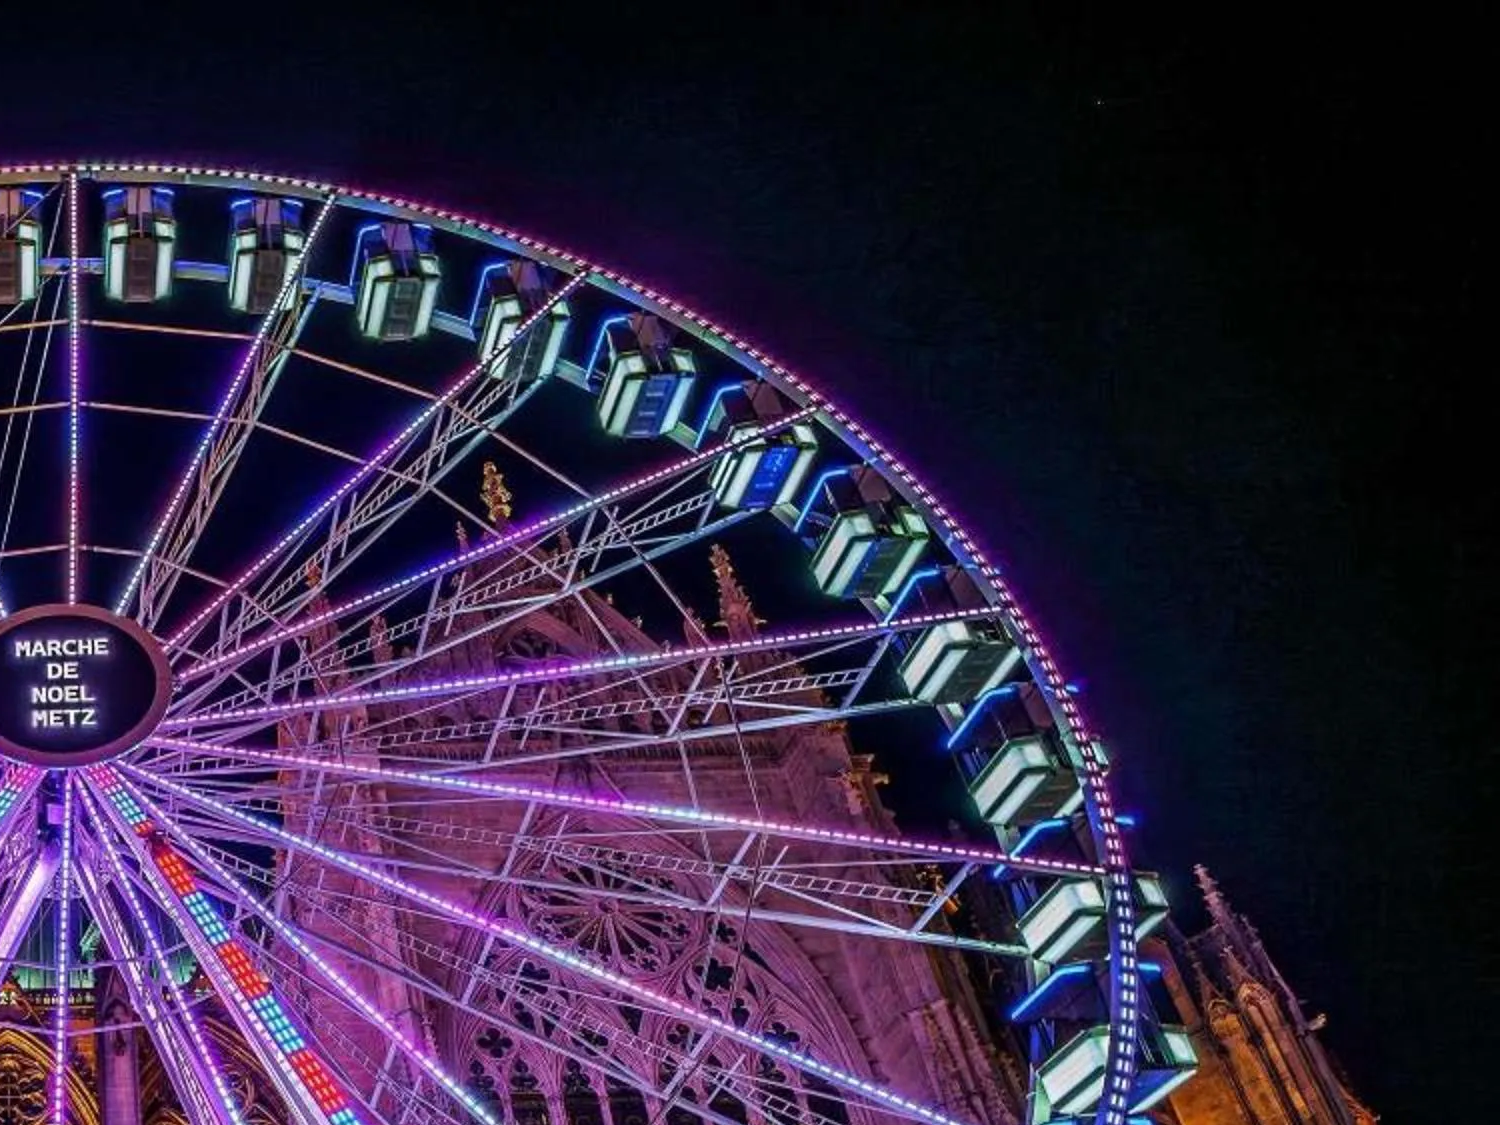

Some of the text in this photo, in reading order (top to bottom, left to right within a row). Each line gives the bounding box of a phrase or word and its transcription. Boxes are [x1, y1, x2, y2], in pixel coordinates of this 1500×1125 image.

[15, 637, 109, 657] MARCHE
[47, 661, 79, 679] DE
[31, 685, 97, 704] NOEL
[31, 708, 98, 728] METZ
